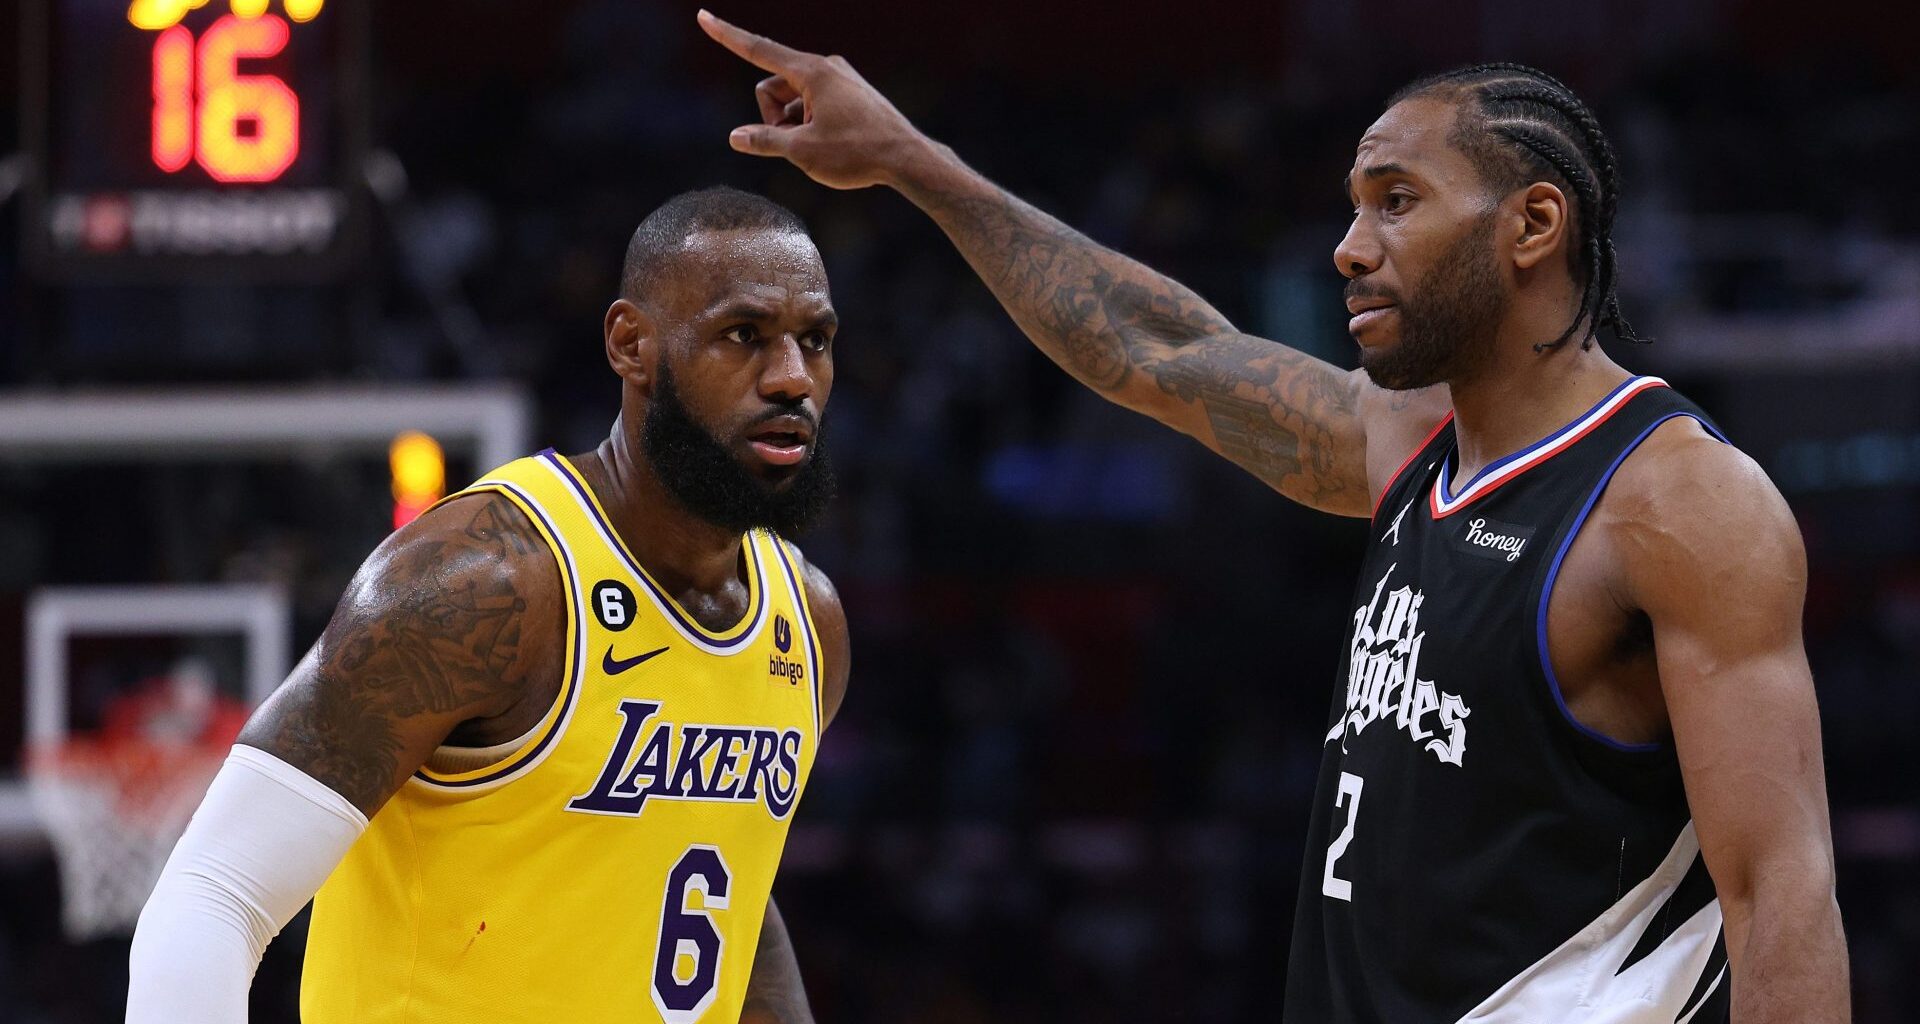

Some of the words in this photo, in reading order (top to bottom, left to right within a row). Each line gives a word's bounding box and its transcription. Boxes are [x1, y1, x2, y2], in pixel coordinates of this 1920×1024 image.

[152, 14, 299, 182] 16
[1465, 518, 1526, 561] honey
[599, 587, 626, 625] 6
[1351, 562, 1424, 657] Los
[769, 654, 803, 685] bibigo
[563, 698, 803, 821] LAKERS
[1322, 771, 1364, 902] 2
[650, 843, 733, 1024] 6
